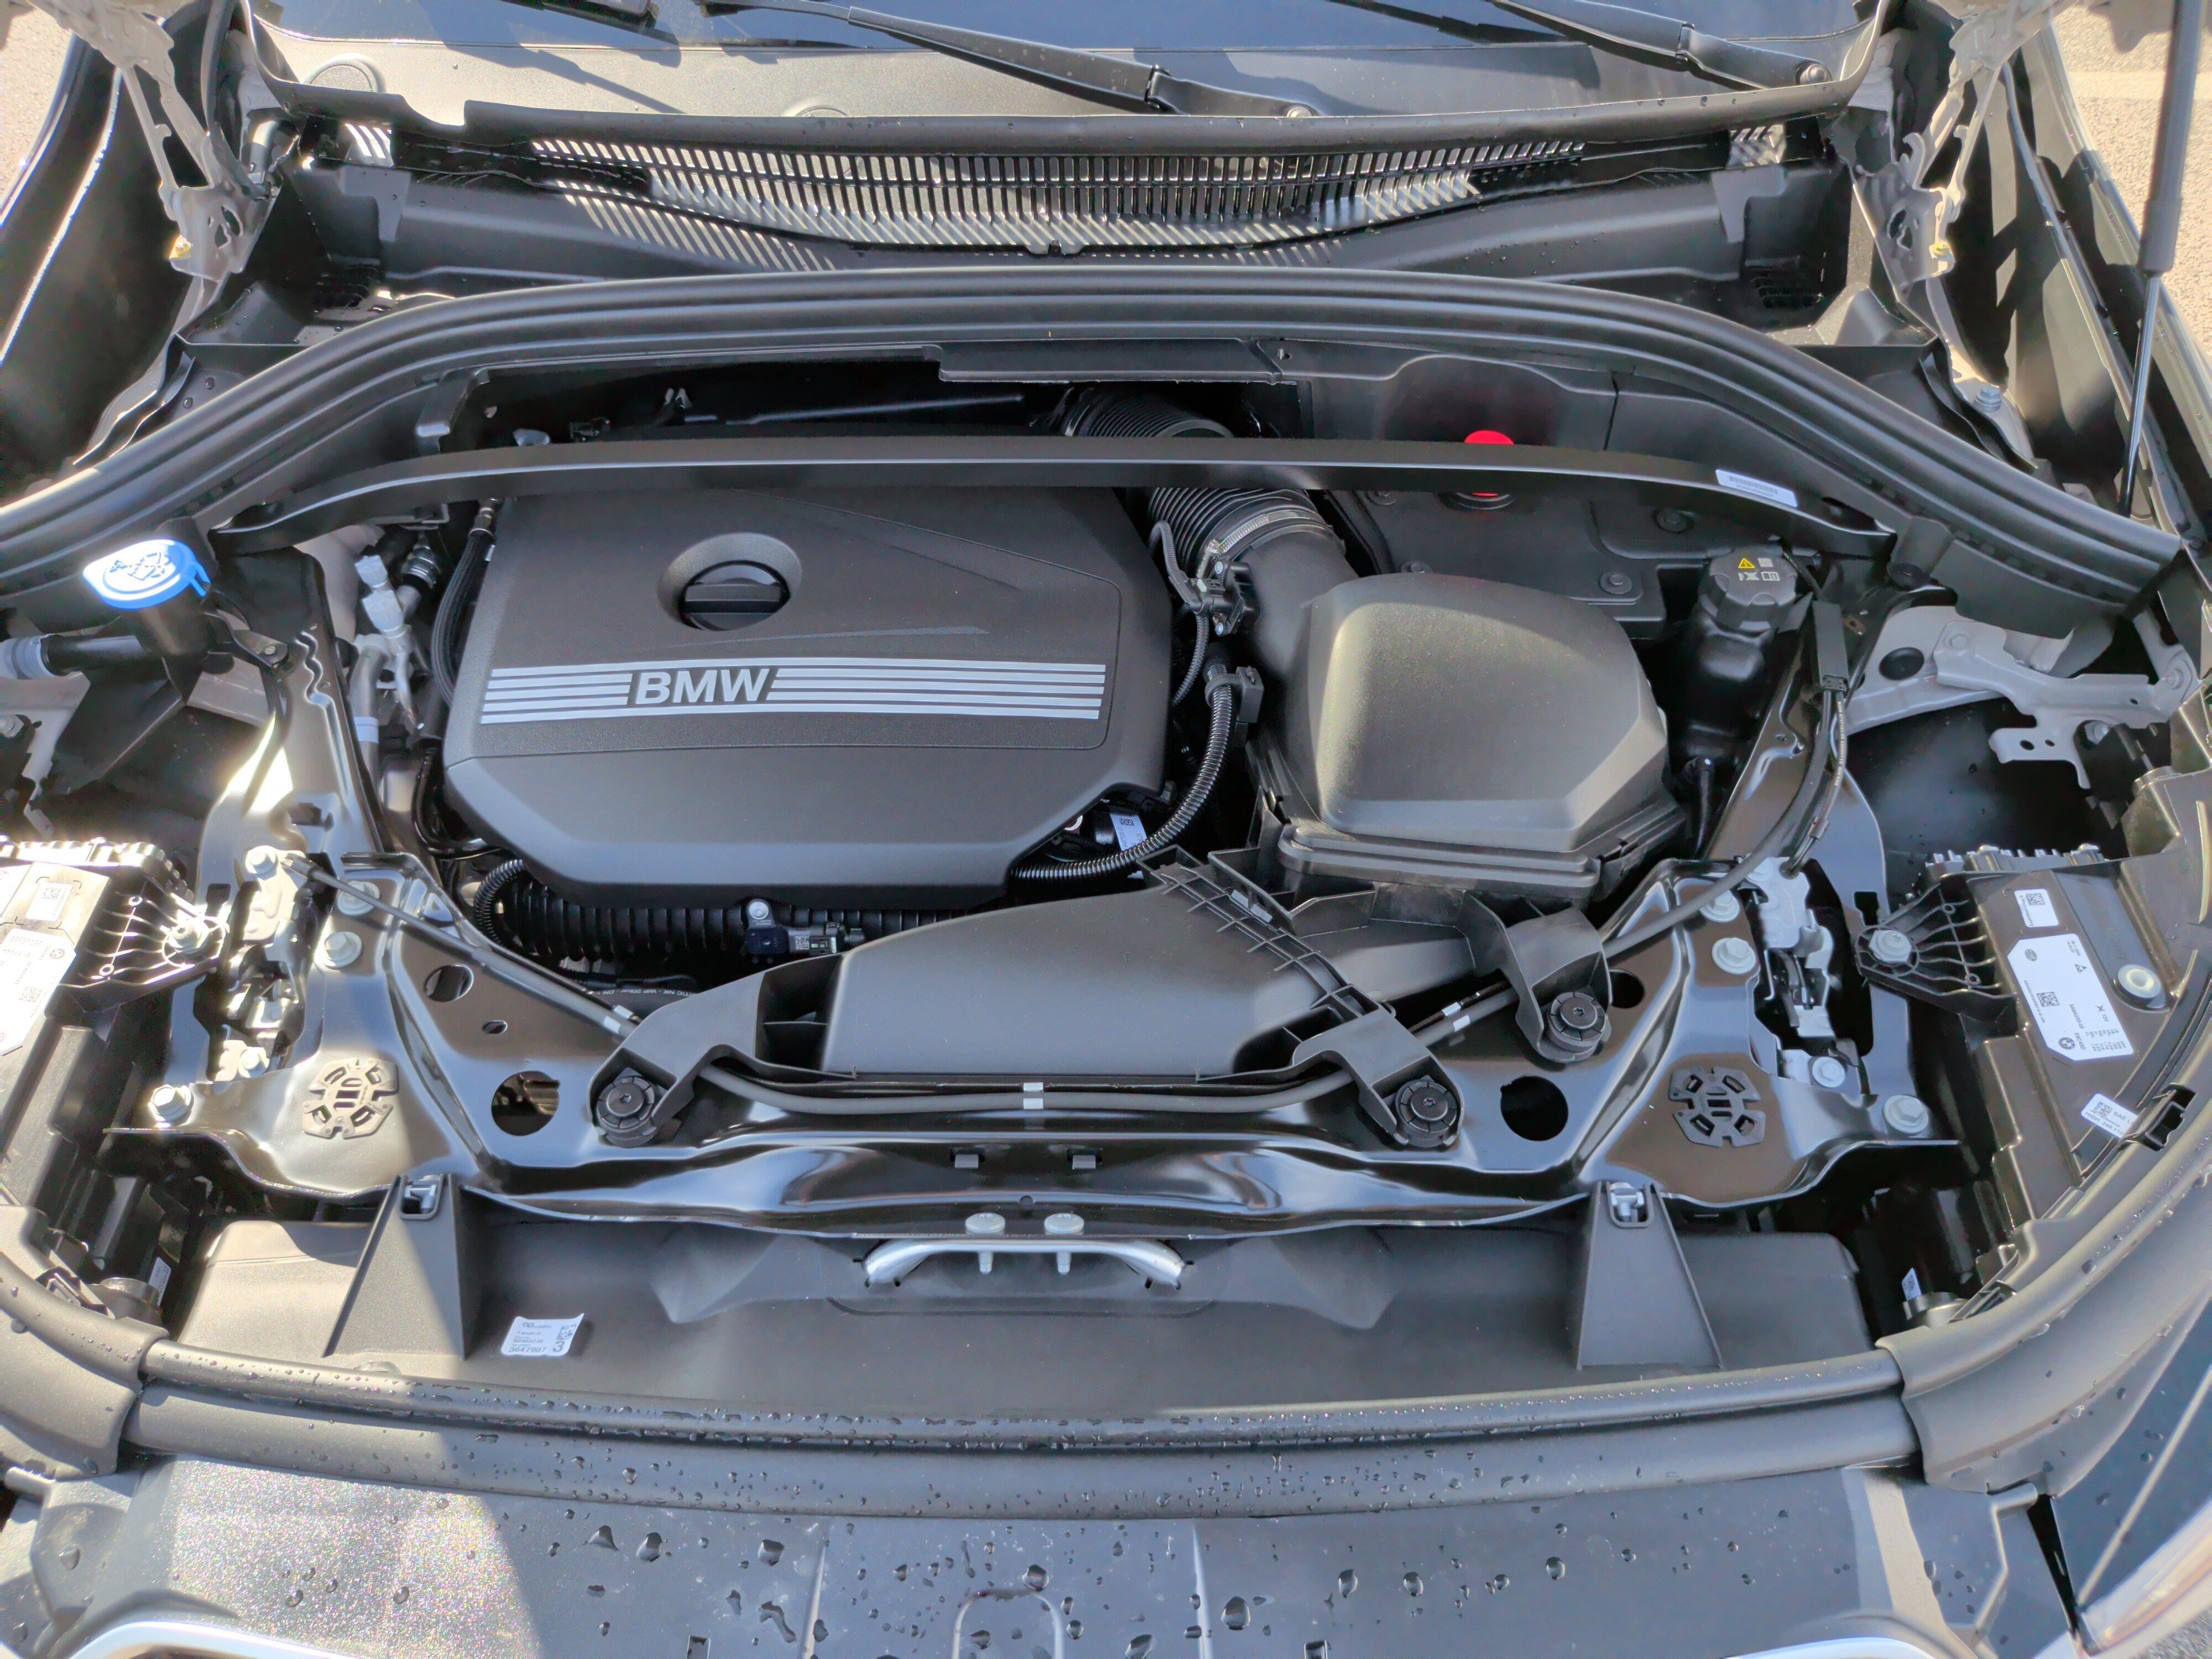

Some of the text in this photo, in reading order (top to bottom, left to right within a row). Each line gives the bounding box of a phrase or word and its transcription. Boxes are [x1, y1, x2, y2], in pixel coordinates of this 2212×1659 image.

[634, 668, 770, 705] BMW
[2100, 1014, 2109, 1022] 12V
[2085, 1112, 2100, 1122] HIGH
[2113, 1111, 2126, 1121] SAE
[552, 1340, 565, 1353] 3
